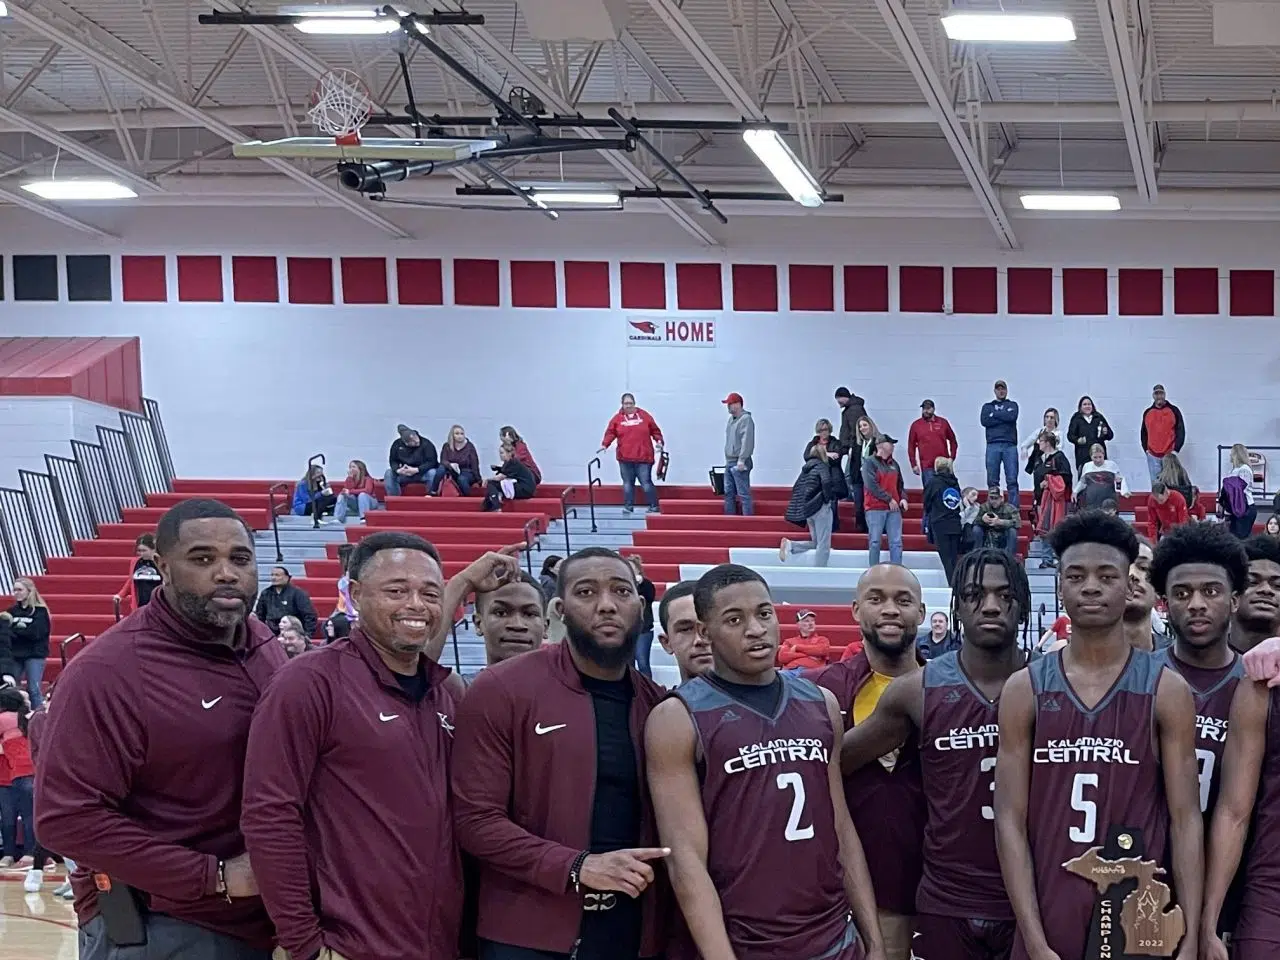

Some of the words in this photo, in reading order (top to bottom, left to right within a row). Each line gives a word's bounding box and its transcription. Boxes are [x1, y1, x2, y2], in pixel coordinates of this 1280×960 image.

[665, 321, 714, 342] HOME
[949, 724, 999, 737] KALAM
[738, 738, 823, 756] KALAMAZOO
[934, 732, 999, 751] CENT
[1033, 746, 1140, 765] CENTRAL
[776, 772, 815, 842] 2
[1069, 773, 1099, 843] 5
[1100, 900, 1112, 959] CHAMPION
[1138, 939, 1165, 948] 2022
